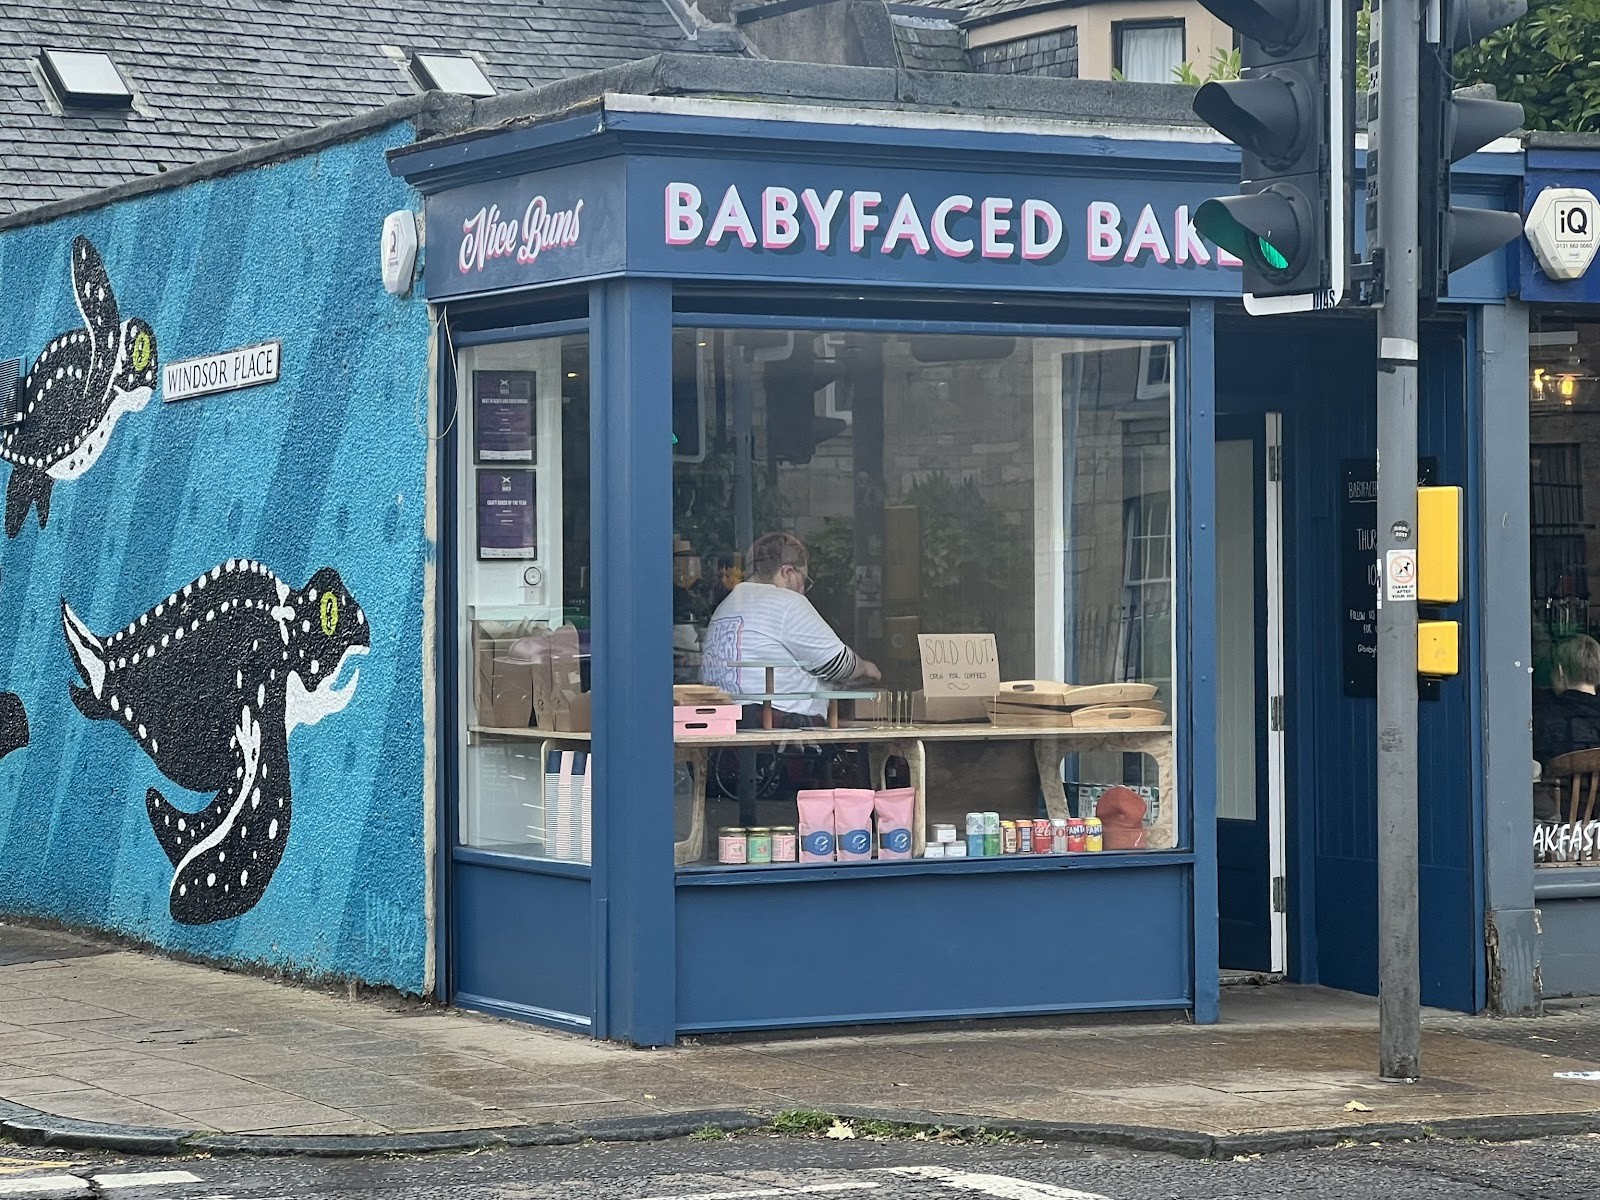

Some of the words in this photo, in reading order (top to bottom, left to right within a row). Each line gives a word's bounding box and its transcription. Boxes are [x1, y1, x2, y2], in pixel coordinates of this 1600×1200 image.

[458, 203, 518, 275] Nice
[517, 194, 584, 265] Buns
[664, 181, 1064, 262] BABYFACED
[1087, 200, 1243, 267] BAK
[1560, 207, 1587, 236] iQ
[167, 359, 228, 394] WINDSOR
[233, 349, 273, 382] PLACE
[925, 638, 959, 666] SOLD
[965, 638, 994, 666] OUT!
[948, 672, 961, 680] FOR
[963, 672, 987, 680] COFFEES
